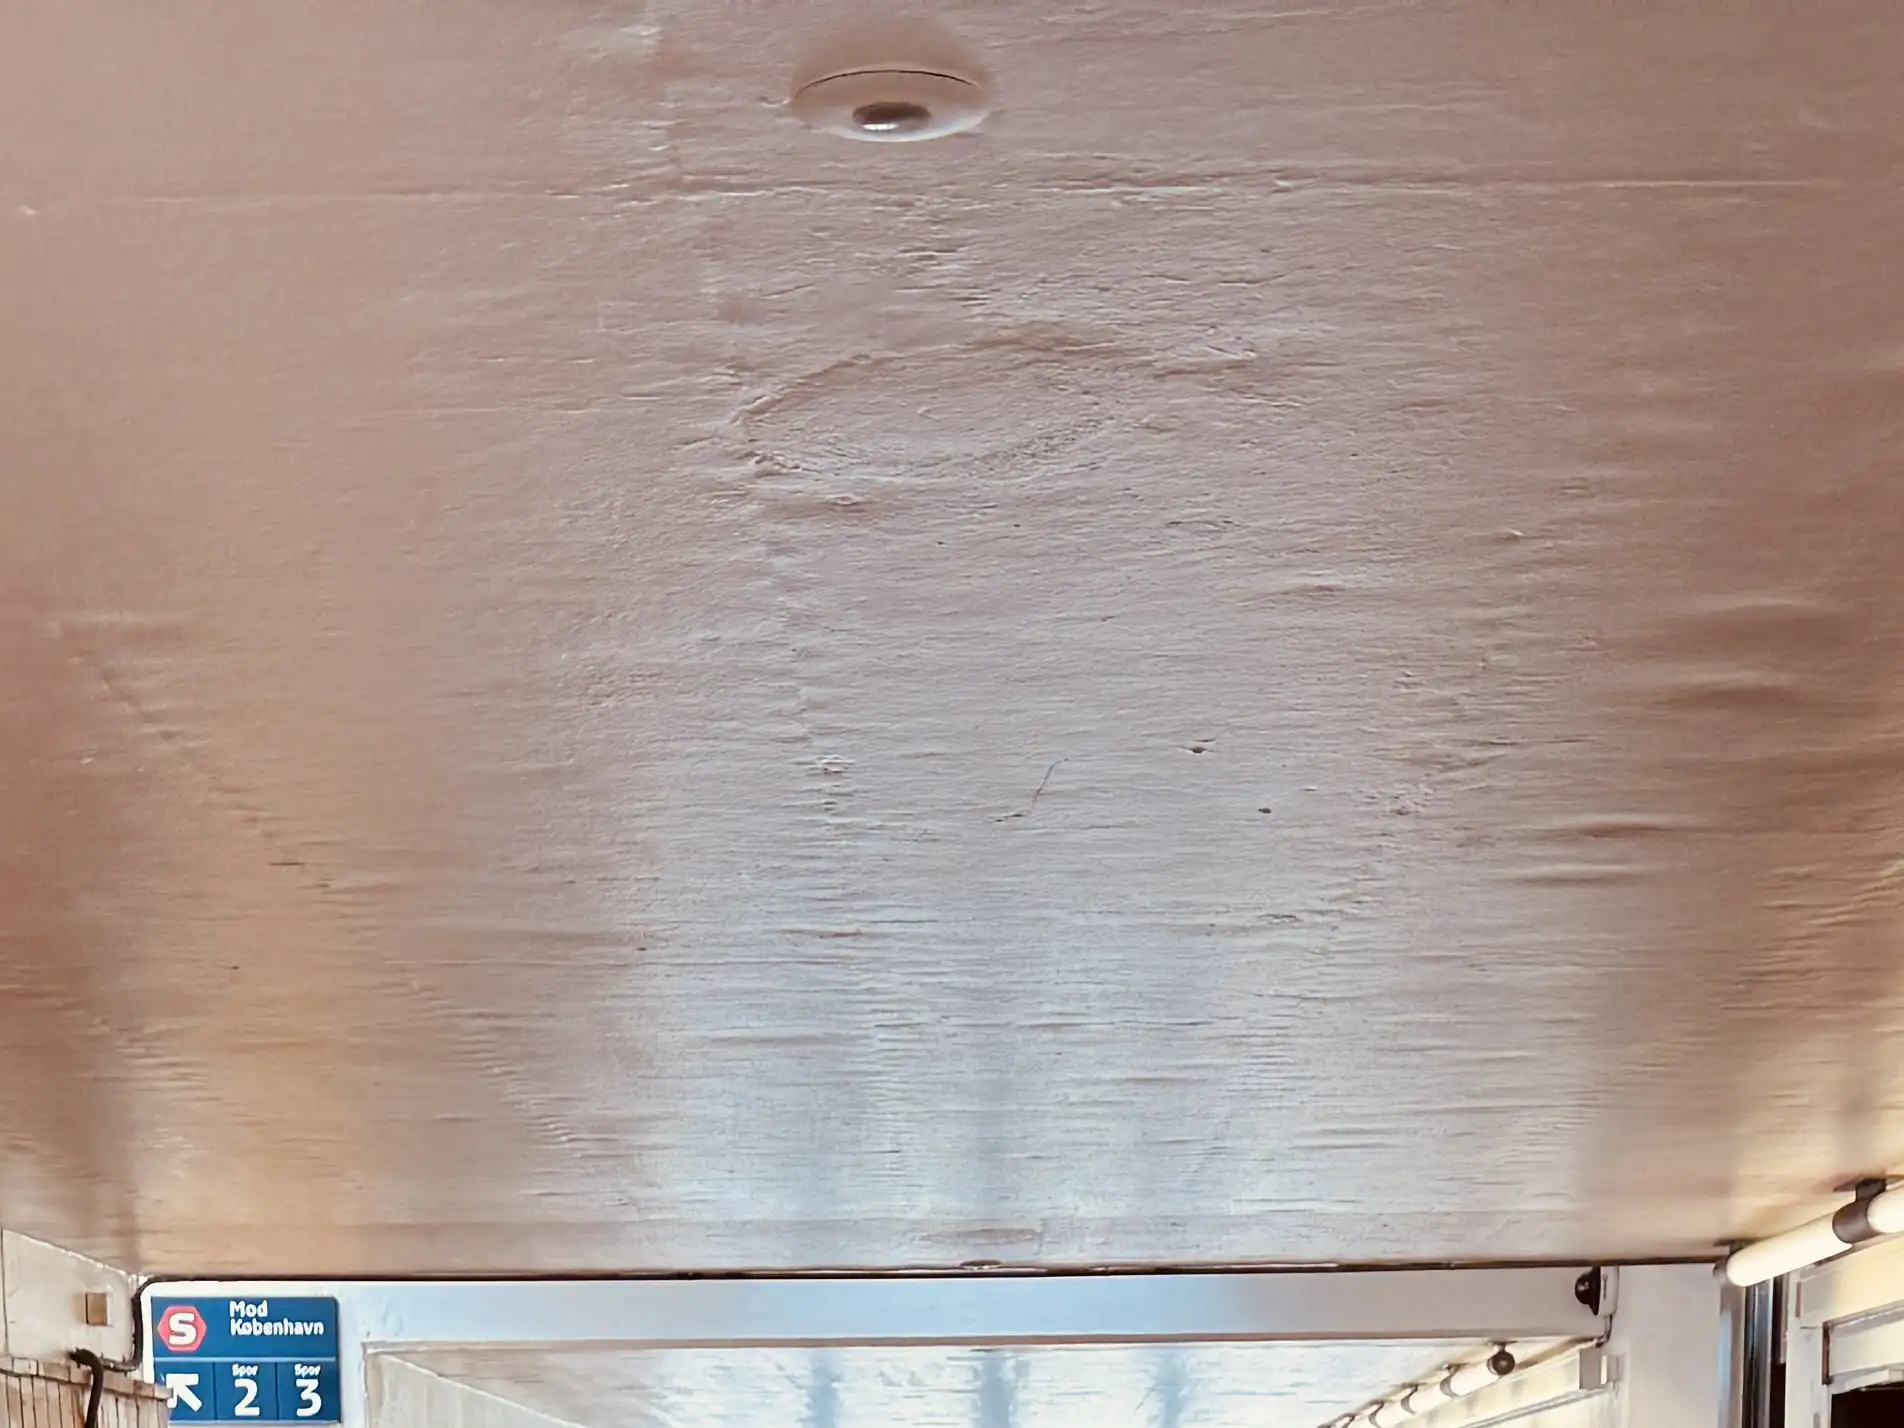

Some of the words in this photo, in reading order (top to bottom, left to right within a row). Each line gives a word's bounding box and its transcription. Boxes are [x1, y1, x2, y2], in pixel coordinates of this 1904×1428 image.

[229, 1300, 269, 1318] Mod
[167, 1312, 197, 1346] S
[230, 1317, 325, 1336] København
[234, 1378, 260, 1417] 2
[296, 1378, 322, 1417] 3
